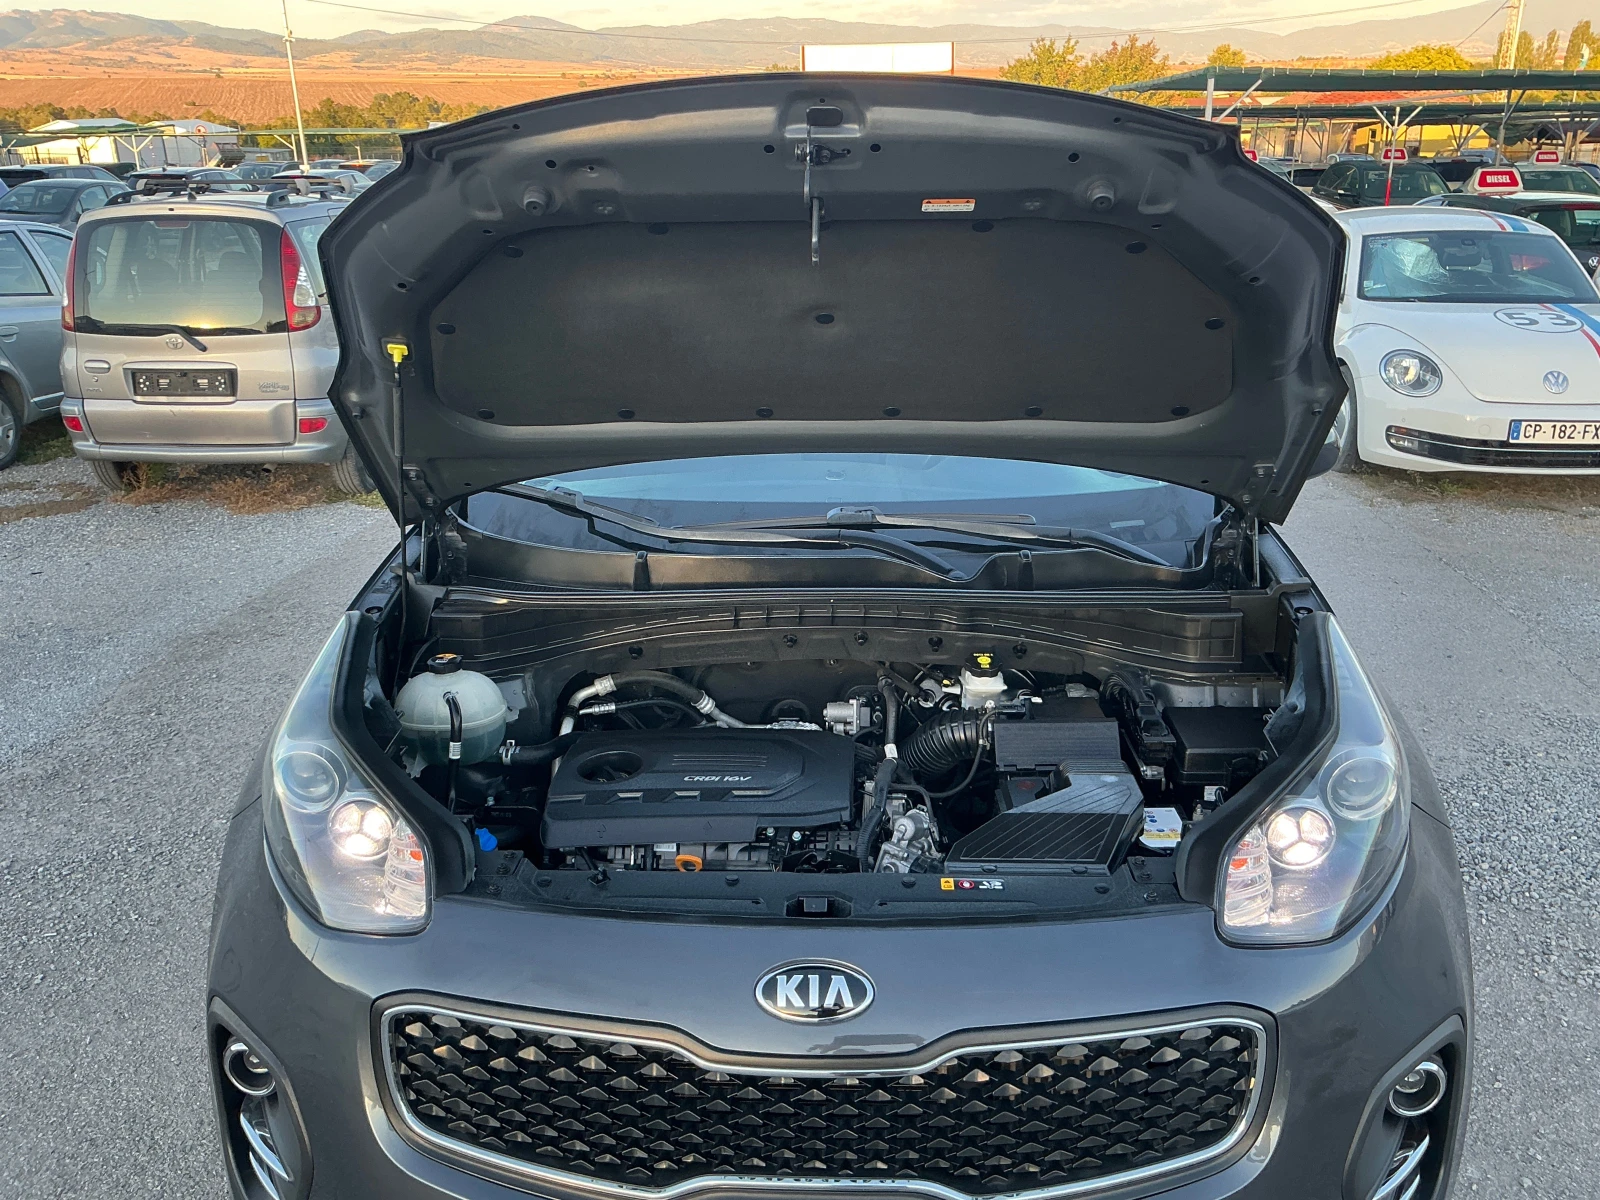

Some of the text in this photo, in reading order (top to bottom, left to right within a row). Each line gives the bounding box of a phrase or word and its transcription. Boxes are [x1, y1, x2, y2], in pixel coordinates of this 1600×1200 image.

[1486, 175, 1511, 183] DIESEL
[1502, 312, 1577, 326] 53
[775, 974, 854, 1008] KIA
